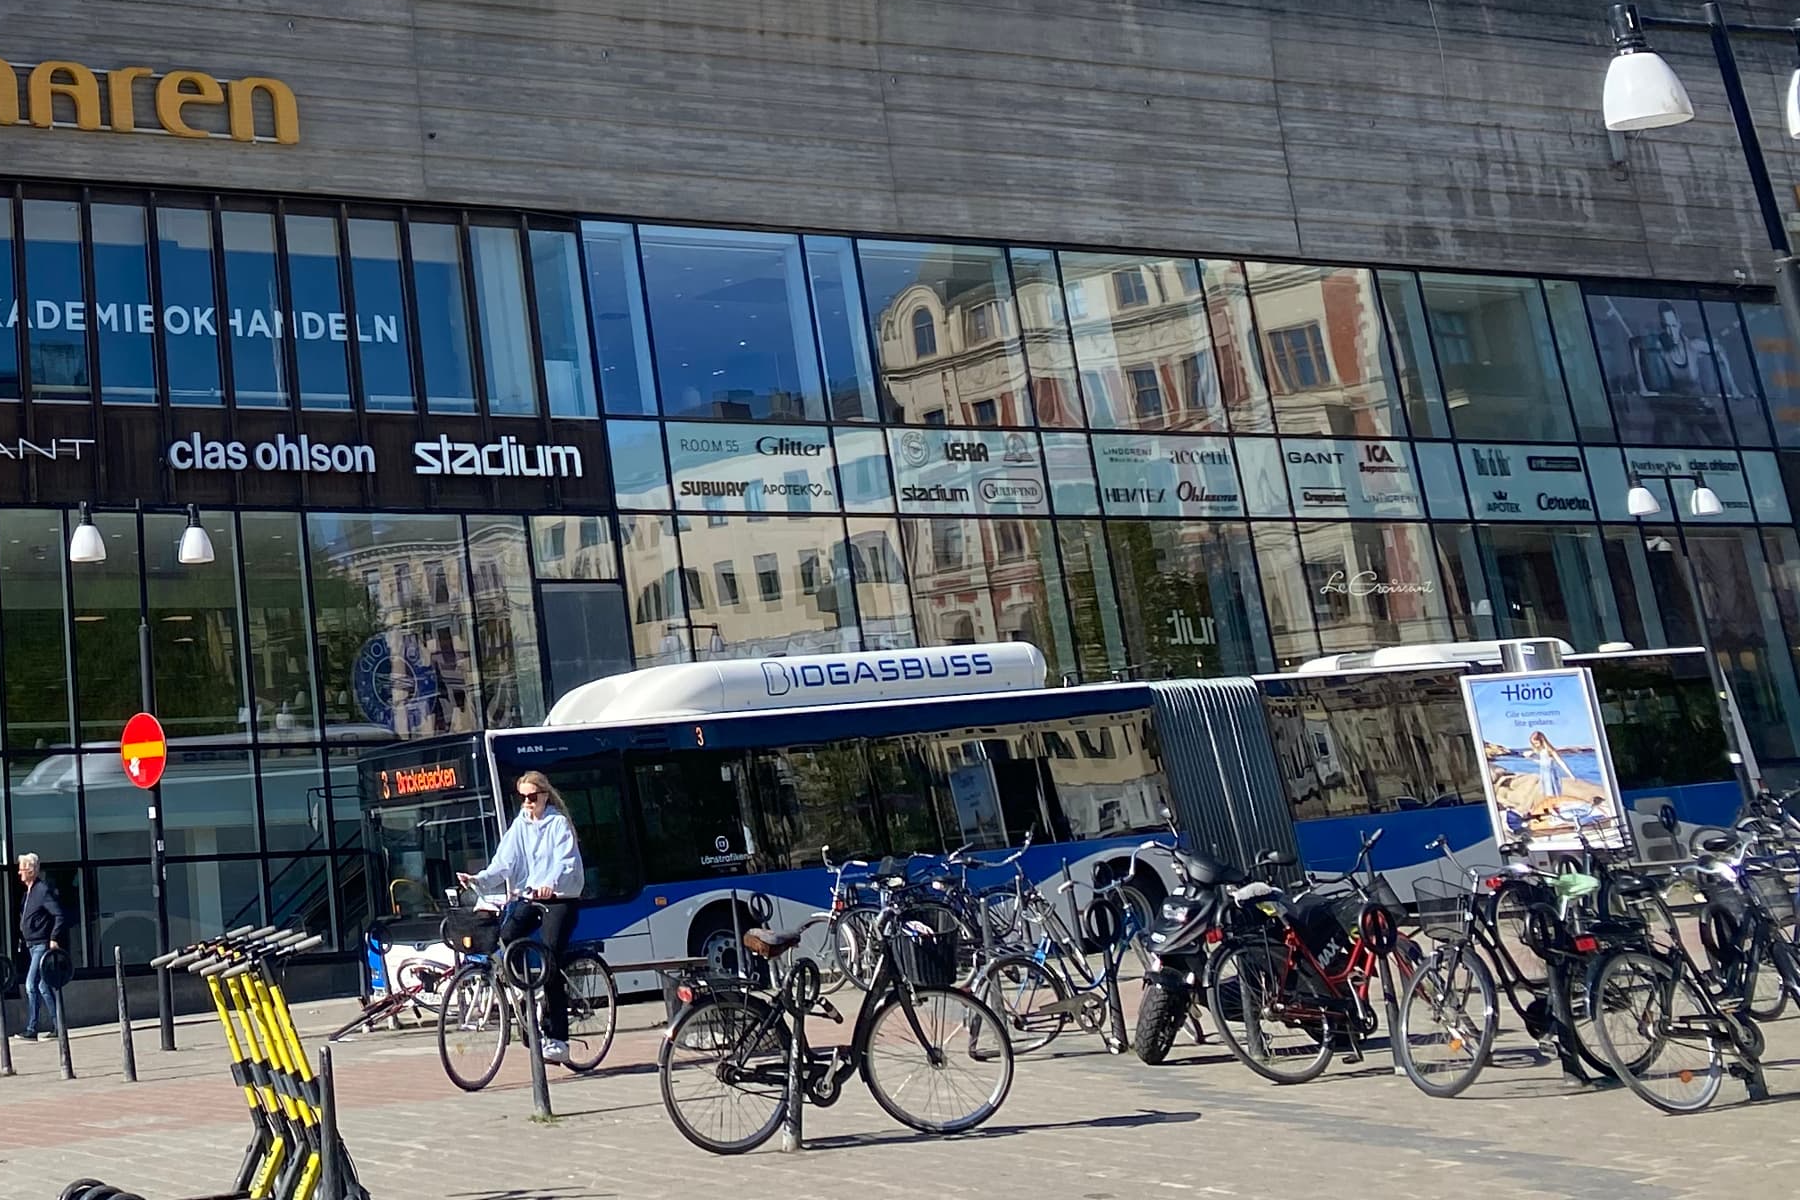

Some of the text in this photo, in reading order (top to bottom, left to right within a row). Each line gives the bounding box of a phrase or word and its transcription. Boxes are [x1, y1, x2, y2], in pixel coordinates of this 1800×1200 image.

[169, 432, 376, 473] clas ohlson
[414, 433, 583, 478] stadium
[755, 436, 826, 457] Glitter
[1170, 448, 1230, 465] accent
[1365, 445, 1394, 463] ICA
[1288, 452, 1345, 464] GANT
[680, 481, 746, 496] SUBWAY
[762, 483, 809, 496] APOTEK
[902, 484, 970, 501] stadium
[1536, 492, 1592, 512] Cervera
[1320, 571, 1435, 597] Le Croissant
[760, 653, 994, 696] BIOGASBUSS
[1501, 681, 1554, 702] Hönö
[695, 726, 705, 747] 3
[517, 745, 544, 754] MAN
[381, 770, 391, 800] 3
